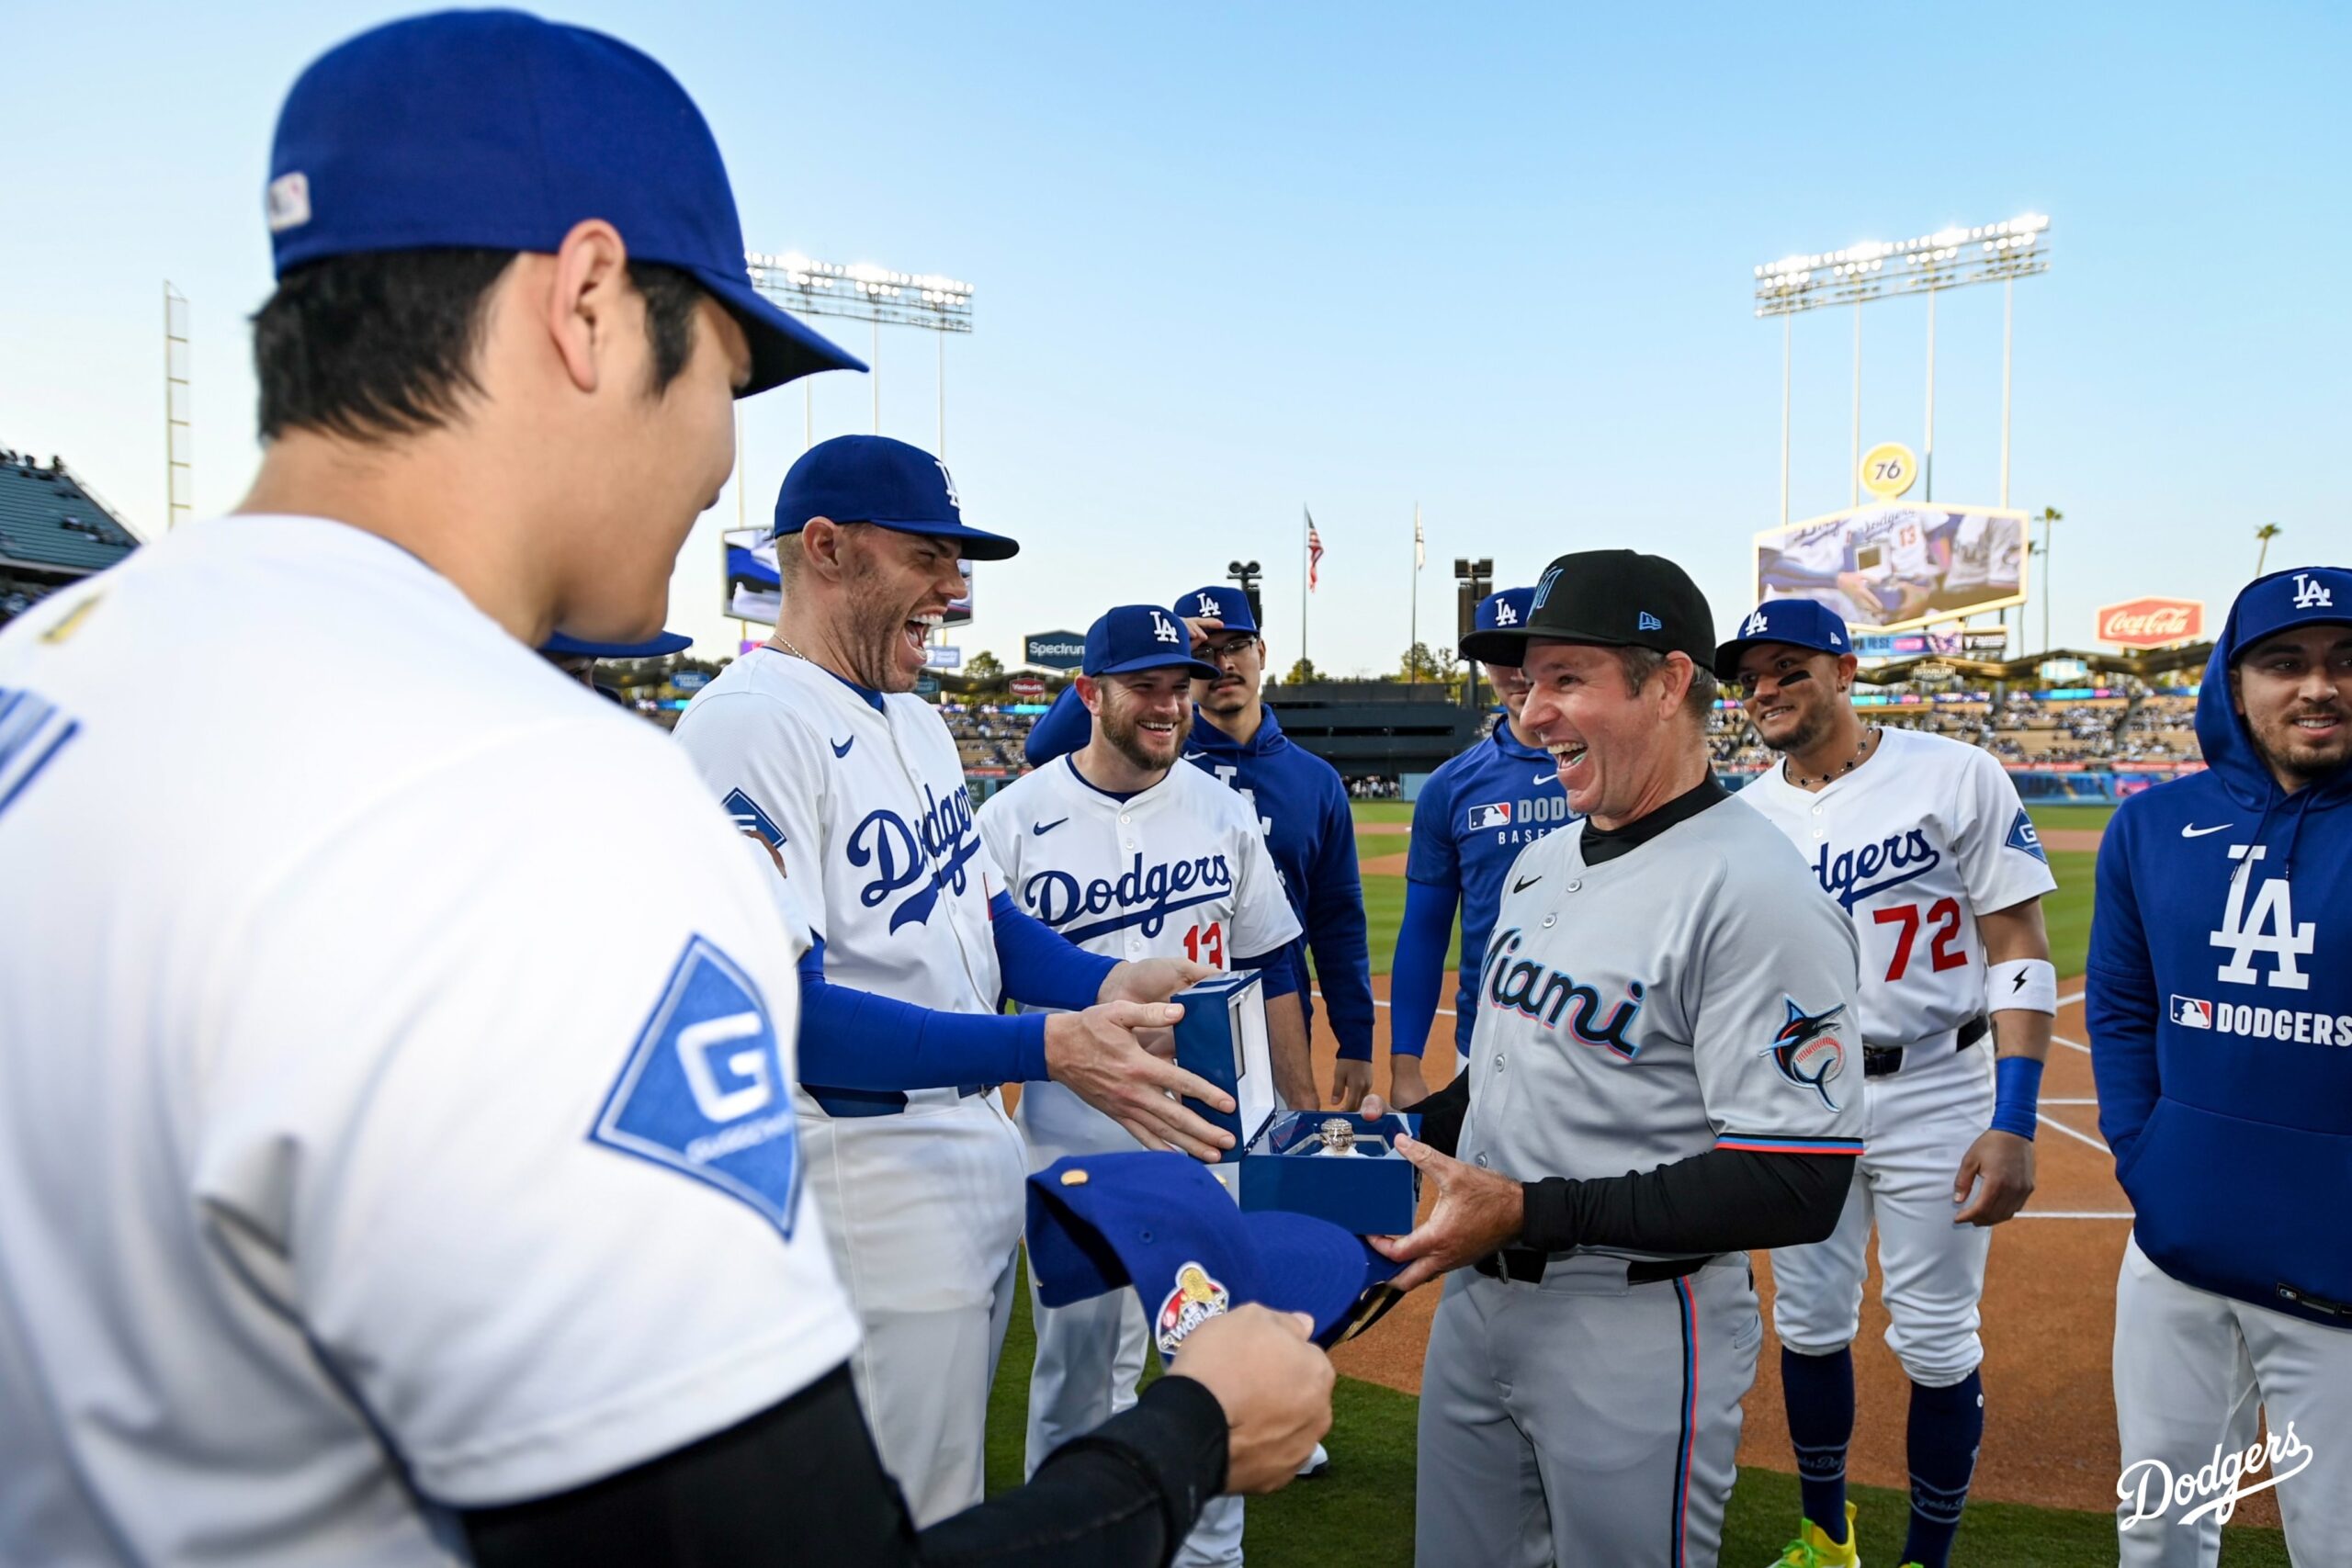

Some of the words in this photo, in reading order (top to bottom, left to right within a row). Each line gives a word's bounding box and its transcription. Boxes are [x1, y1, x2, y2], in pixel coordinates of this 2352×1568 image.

[1875, 459, 1902, 480] 76
[1196, 592, 1222, 617] LA
[2292, 573, 2333, 609] LA
[1149, 611, 1180, 643] LA
[1496, 598, 1518, 626] LA
[1746, 611, 1768, 637] LA
[2105, 607, 2192, 637] Coca-Cola
[1498, 828, 1558, 844] BASE
[1024, 852, 1232, 945] Dodgers
[2210, 844, 2315, 990] LA
[1872, 897, 1969, 983] 72
[2216, 1002, 2352, 1047] DODGERS
[676, 1010, 771, 1123] G
